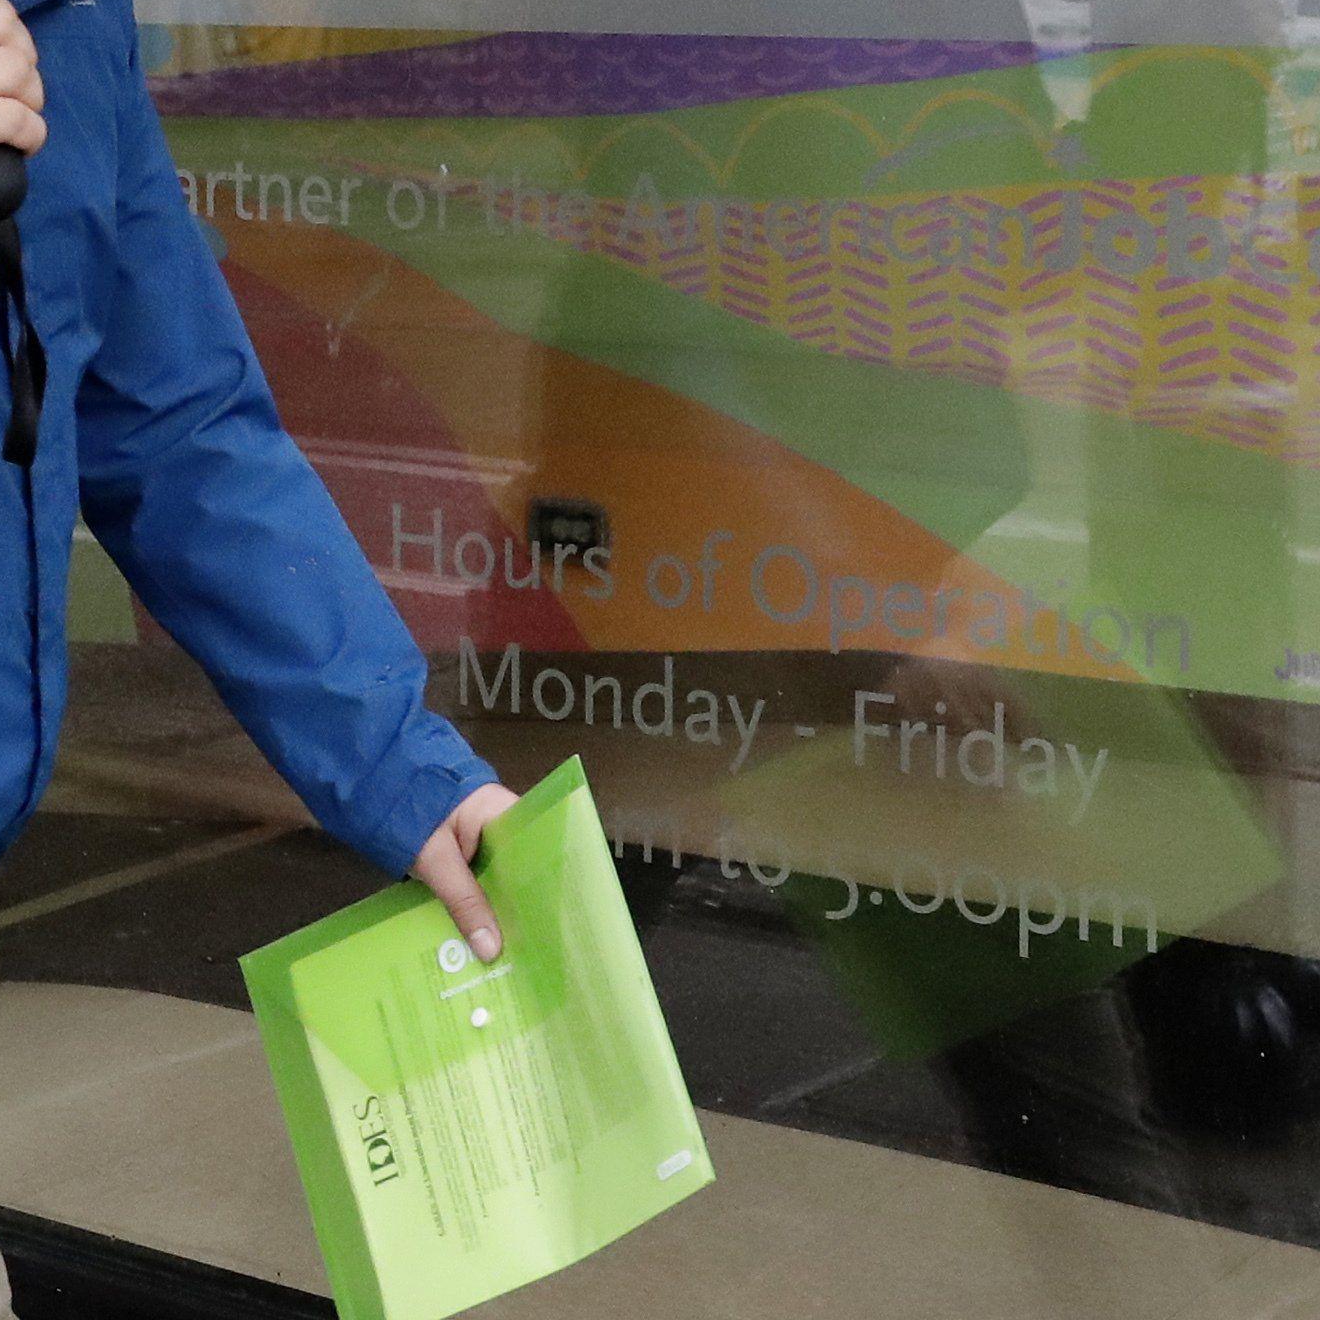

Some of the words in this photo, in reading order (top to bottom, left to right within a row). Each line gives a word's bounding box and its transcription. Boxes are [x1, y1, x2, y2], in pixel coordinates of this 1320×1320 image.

[177, 162, 364, 227] artner
[386, 171, 457, 231] of
[485, 168, 593, 239] the
[391, 502, 614, 598] Hours
[647, 529, 731, 613] of
[751, 544, 1192, 674] Operation
[458, 635, 766, 772] Monday
[853, 690, 1110, 827] Friday
[353, 1093, 400, 1188] IDES
